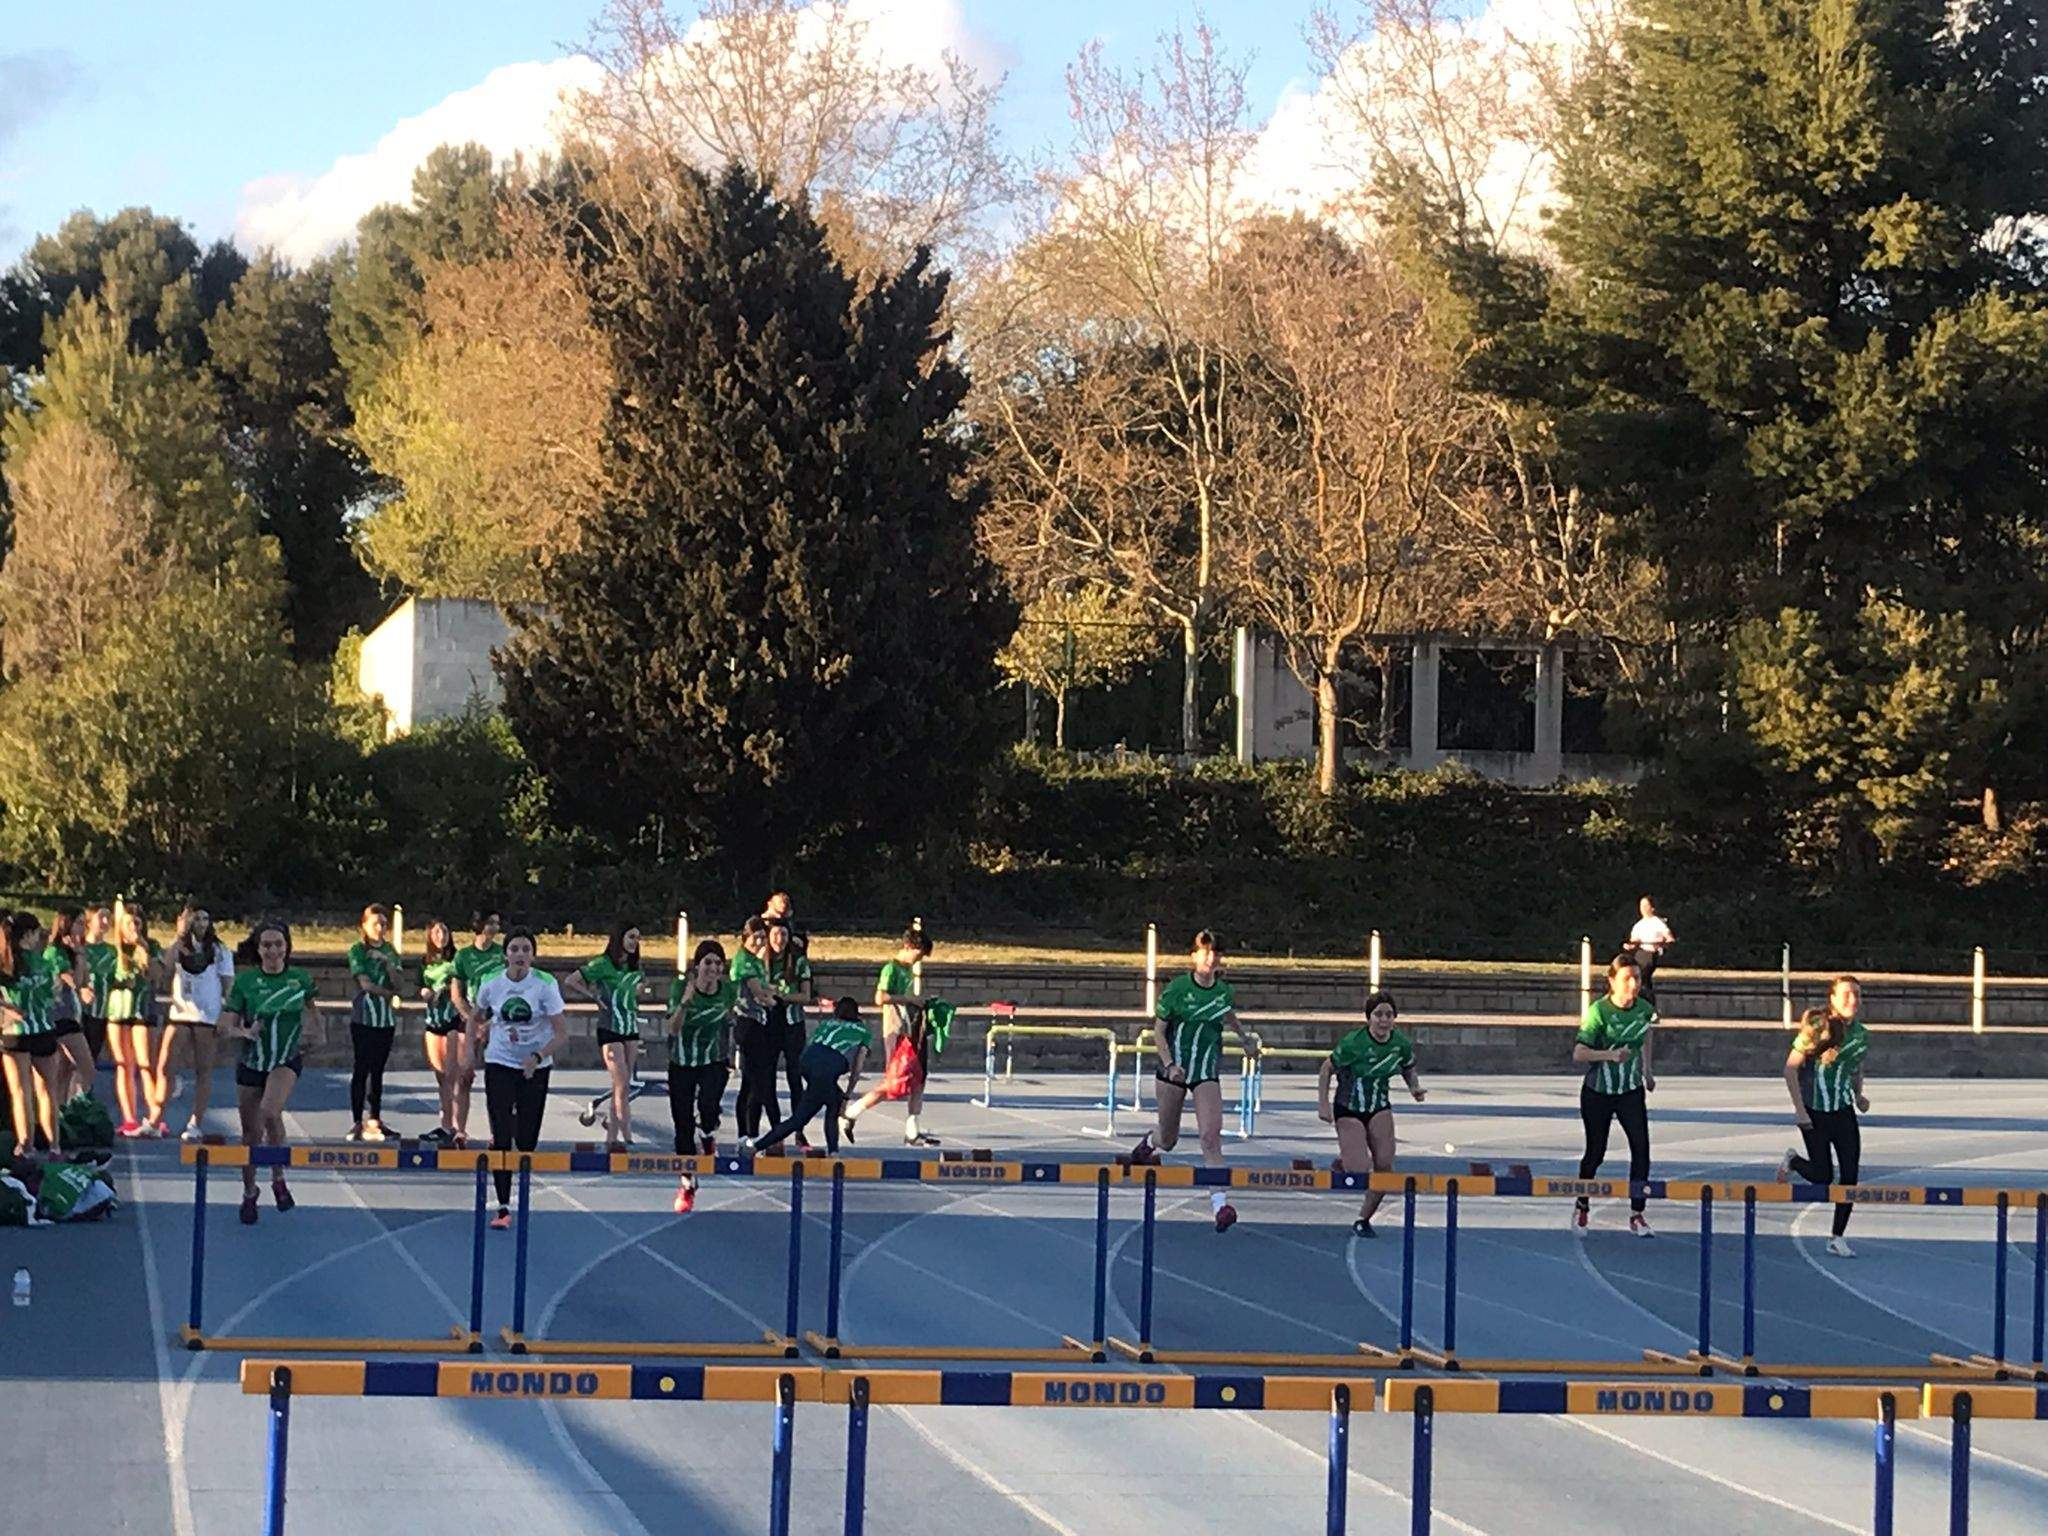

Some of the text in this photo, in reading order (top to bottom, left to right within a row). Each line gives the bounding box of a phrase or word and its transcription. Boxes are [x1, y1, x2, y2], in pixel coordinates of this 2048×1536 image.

[471, 1370, 599, 1395] MONDO
[1045, 1381, 1166, 1404] MONDO
[1597, 1390, 1714, 1412] MONDO
